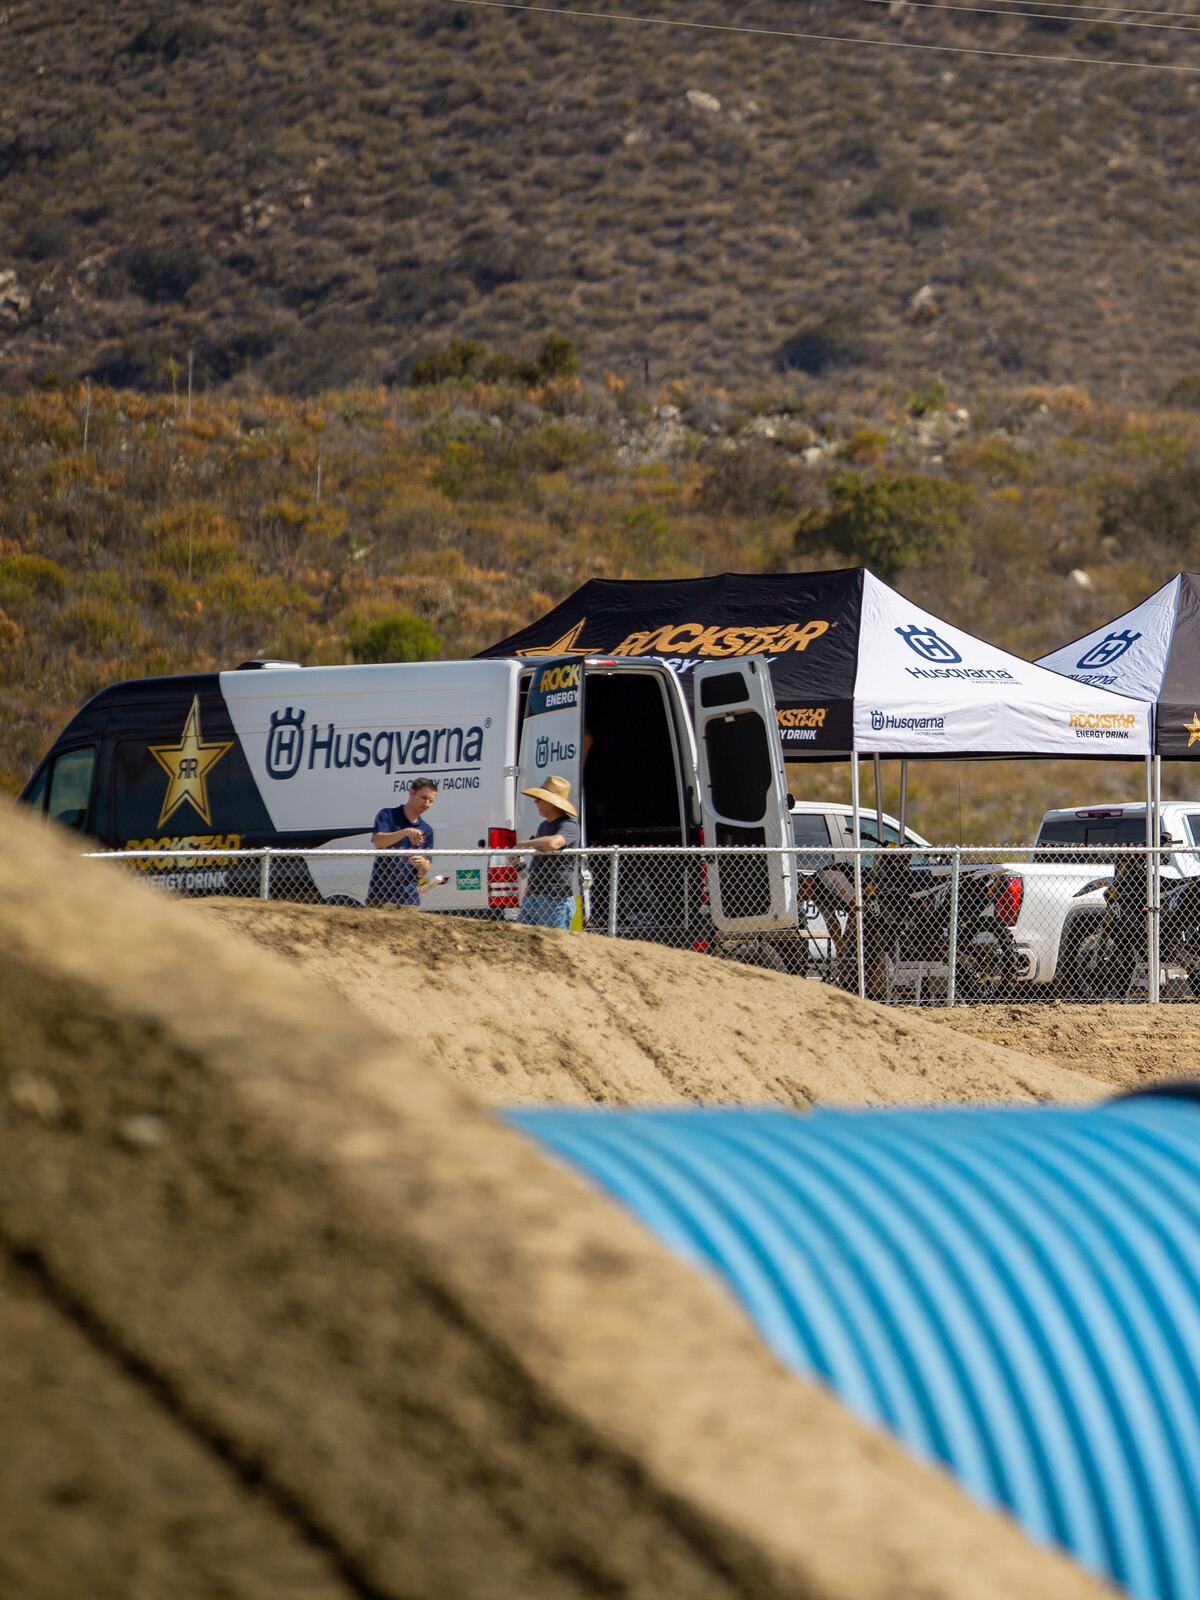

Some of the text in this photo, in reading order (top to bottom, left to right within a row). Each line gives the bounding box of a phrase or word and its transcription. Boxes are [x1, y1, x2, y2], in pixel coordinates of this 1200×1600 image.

[608, 620, 829, 656] ROCKSTAR
[904, 667, 1014, 680] Husqvarna
[546, 690, 577, 707] ENERGY
[886, 715, 944, 730] Husqvarna
[1069, 714, 1135, 728] ROCKSTAR
[787, 729, 816, 740] DRINK
[1076, 730, 1104, 738] ENERGY
[307, 723, 484, 774] Husqvarna
[185, 871, 227, 889] DRINK
